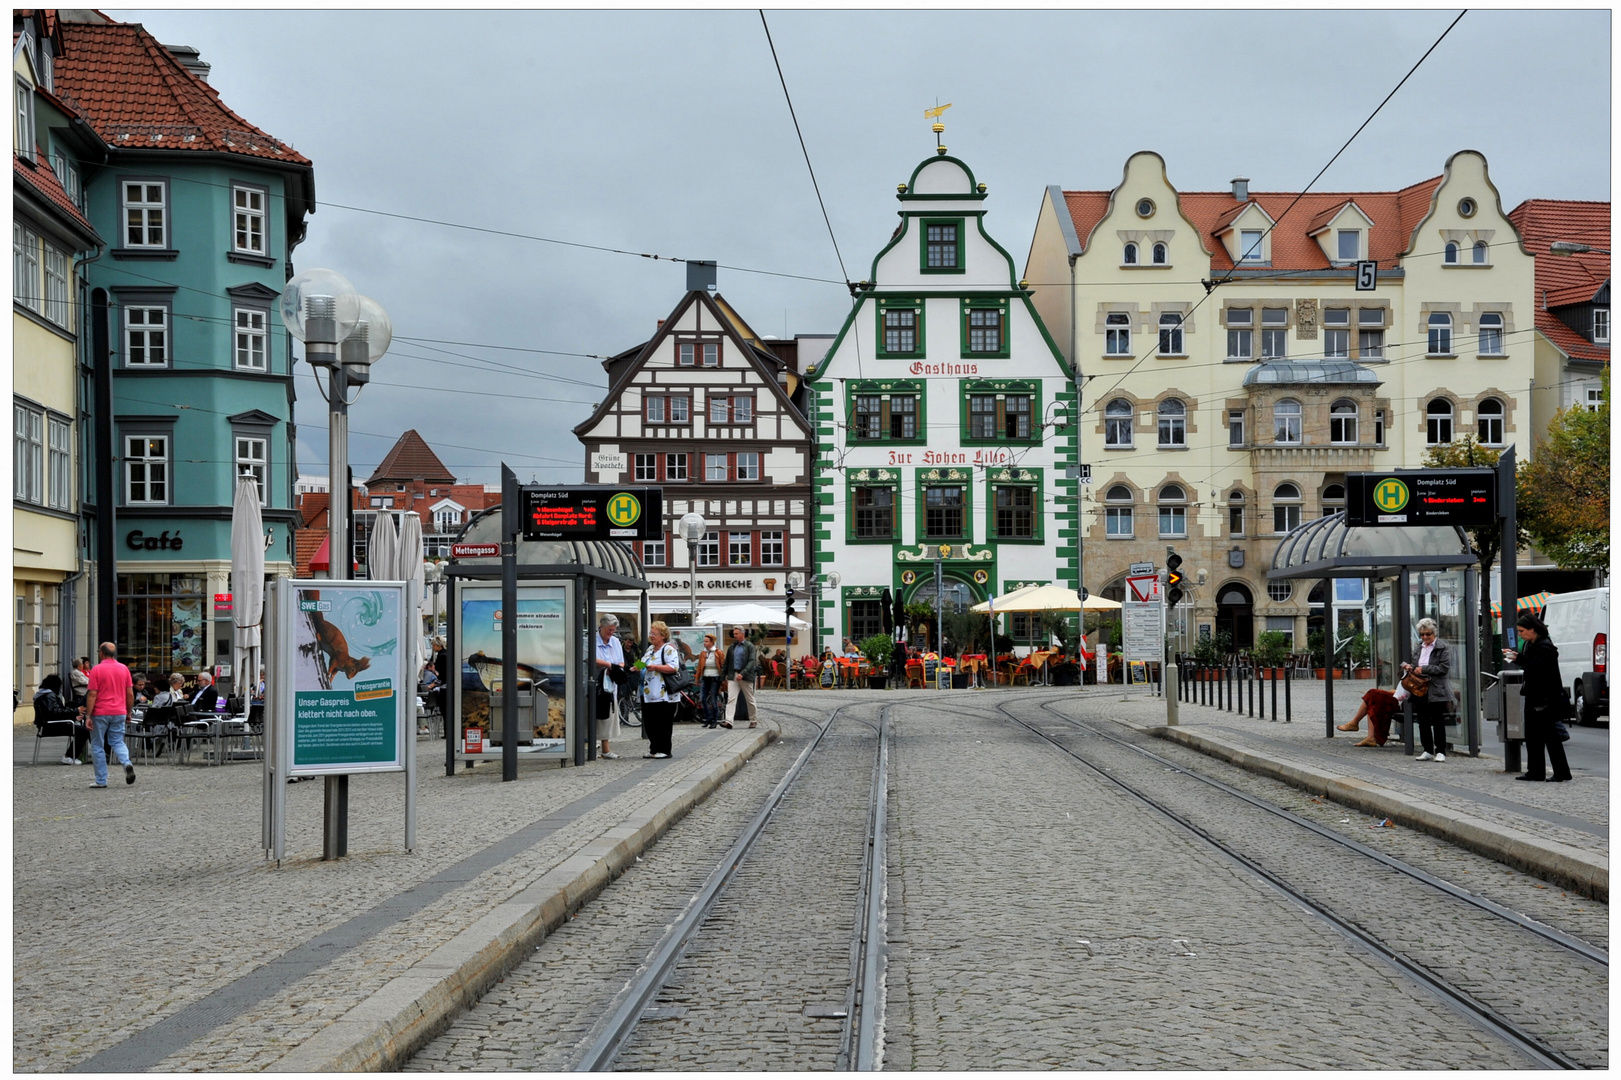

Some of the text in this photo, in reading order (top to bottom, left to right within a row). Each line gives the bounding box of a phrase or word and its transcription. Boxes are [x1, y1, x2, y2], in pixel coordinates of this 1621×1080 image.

[1361, 264, 1372, 287] 5
[909, 361, 978, 376] Gasthaus
[888, 449, 1006, 466] Zur Hohen Lilie
[1081, 465, 1090, 477] H
[1383, 485, 1400, 505] H
[615, 500, 632, 519] H
[126, 530, 183, 550] Café
[455, 546, 496, 556] Mettengasse
[648, 580, 753, 589] THOS-DR GRIECHE
[301, 601, 316, 610] SWE
[356, 680, 391, 691] Preisgarantie
[298, 698, 350, 707] Unser Gaspreis
[298, 709, 378, 719] klettert nicht nach oben.
